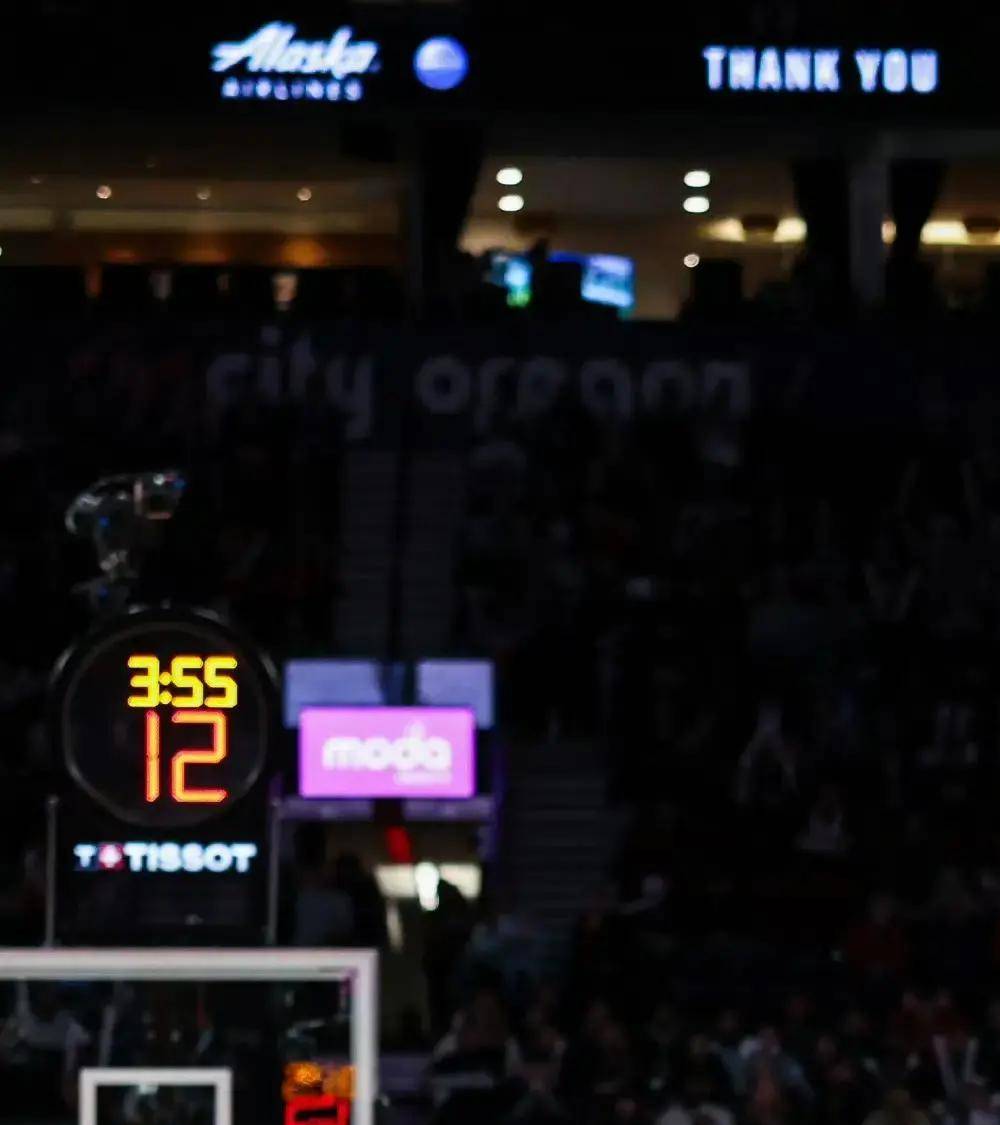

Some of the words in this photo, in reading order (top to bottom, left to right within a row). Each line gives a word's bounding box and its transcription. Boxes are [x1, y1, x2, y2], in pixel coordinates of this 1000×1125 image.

[210, 21, 379, 79] Alaska
[702, 46, 841, 92] THANK
[855, 48, 938, 93] YOU
[127, 656, 239, 708] 3:55
[145, 711, 228, 803] 12
[322, 719, 452, 772] moda
[123, 843, 258, 873] TISSOT
